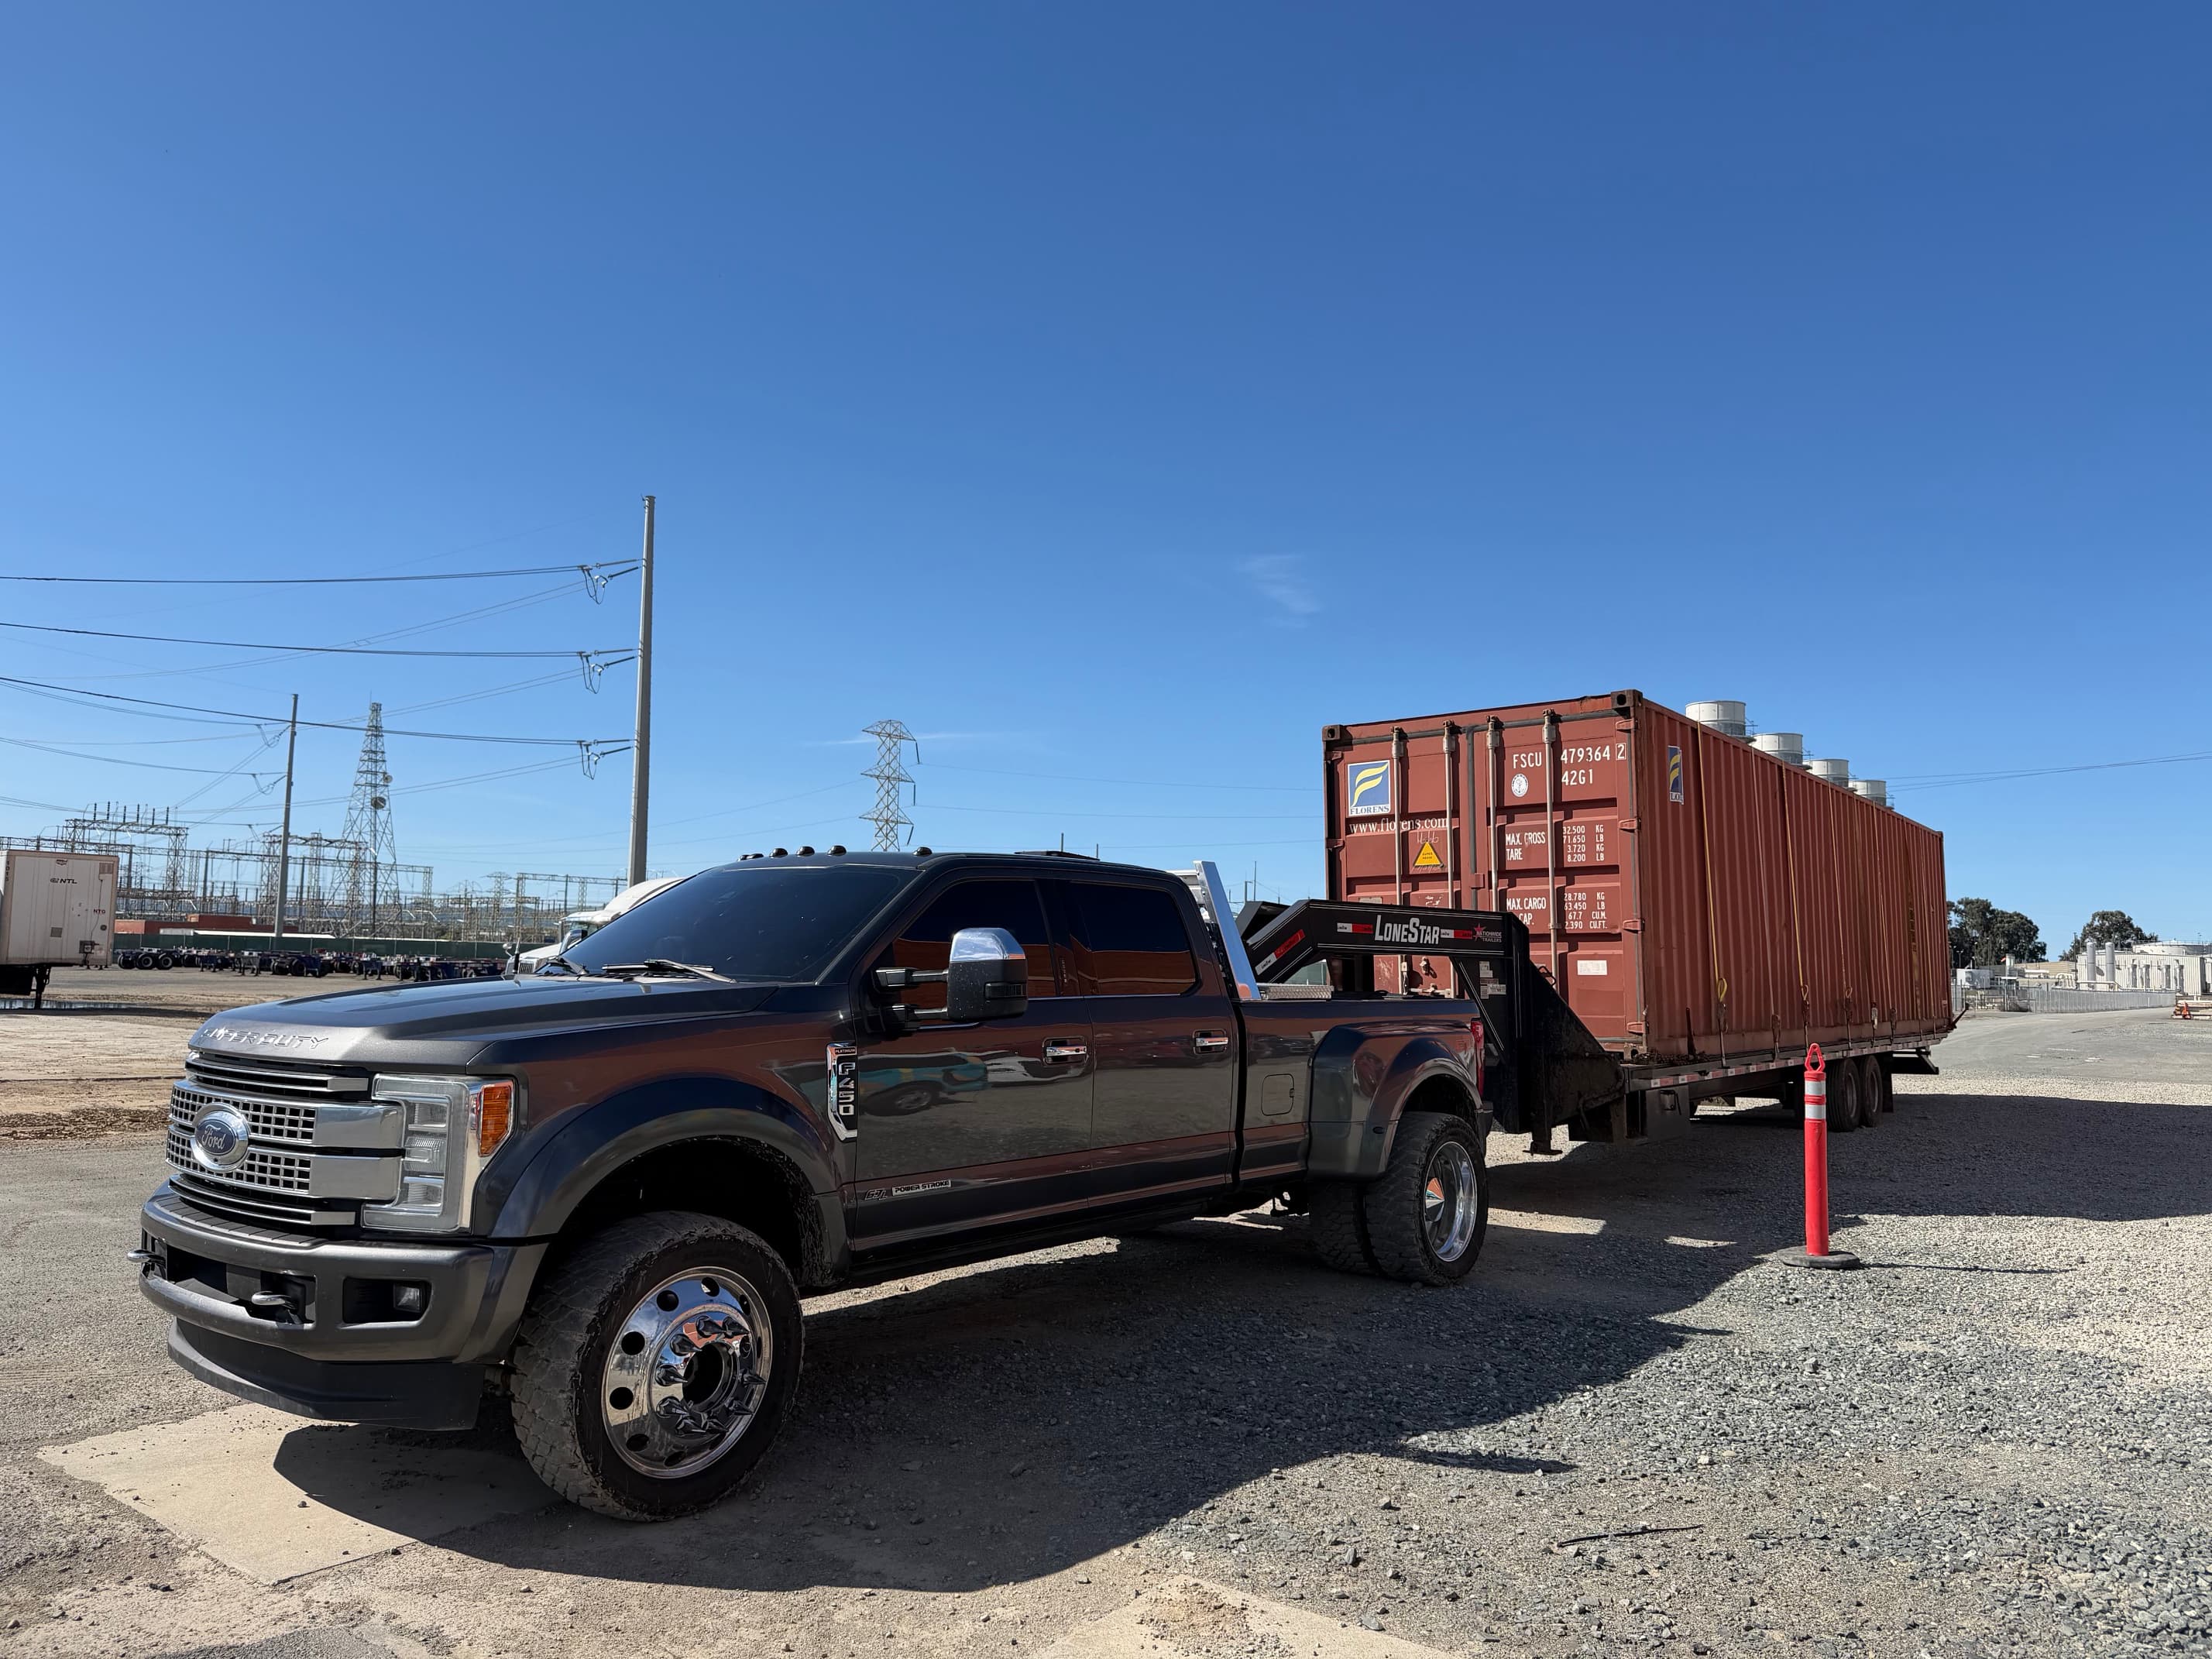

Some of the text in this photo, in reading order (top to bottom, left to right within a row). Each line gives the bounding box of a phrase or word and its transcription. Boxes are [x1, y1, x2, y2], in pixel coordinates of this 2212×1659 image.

[1513, 744, 1626, 769] FSCU 479364 2
[1561, 768, 1593, 785] 42G1
[1350, 805, 1389, 815] FLORENS
[1349, 817, 1448, 833] www.floens.com
[1563, 826, 1585, 834] 32.500
[1506, 833, 1523, 846] MAX.
[1563, 834, 1604, 843] 71.650 LB
[1506, 843, 1604, 860] TARE 3.720 KG
[1567, 853, 1605, 862] 8.200 LB
[1564, 891, 1605, 901] 28.780 KG
[1506, 897, 1547, 910] MAX. CARGO
[1597, 902, 1606, 910] LB
[1568, 912, 1582, 920] 67.7
[1565, 921, 1583, 929] 2.390
[201, 1124, 227, 1150] Ford
[895, 1184, 920, 1194] POWER
[921, 1180, 950, 1190] STROKE
